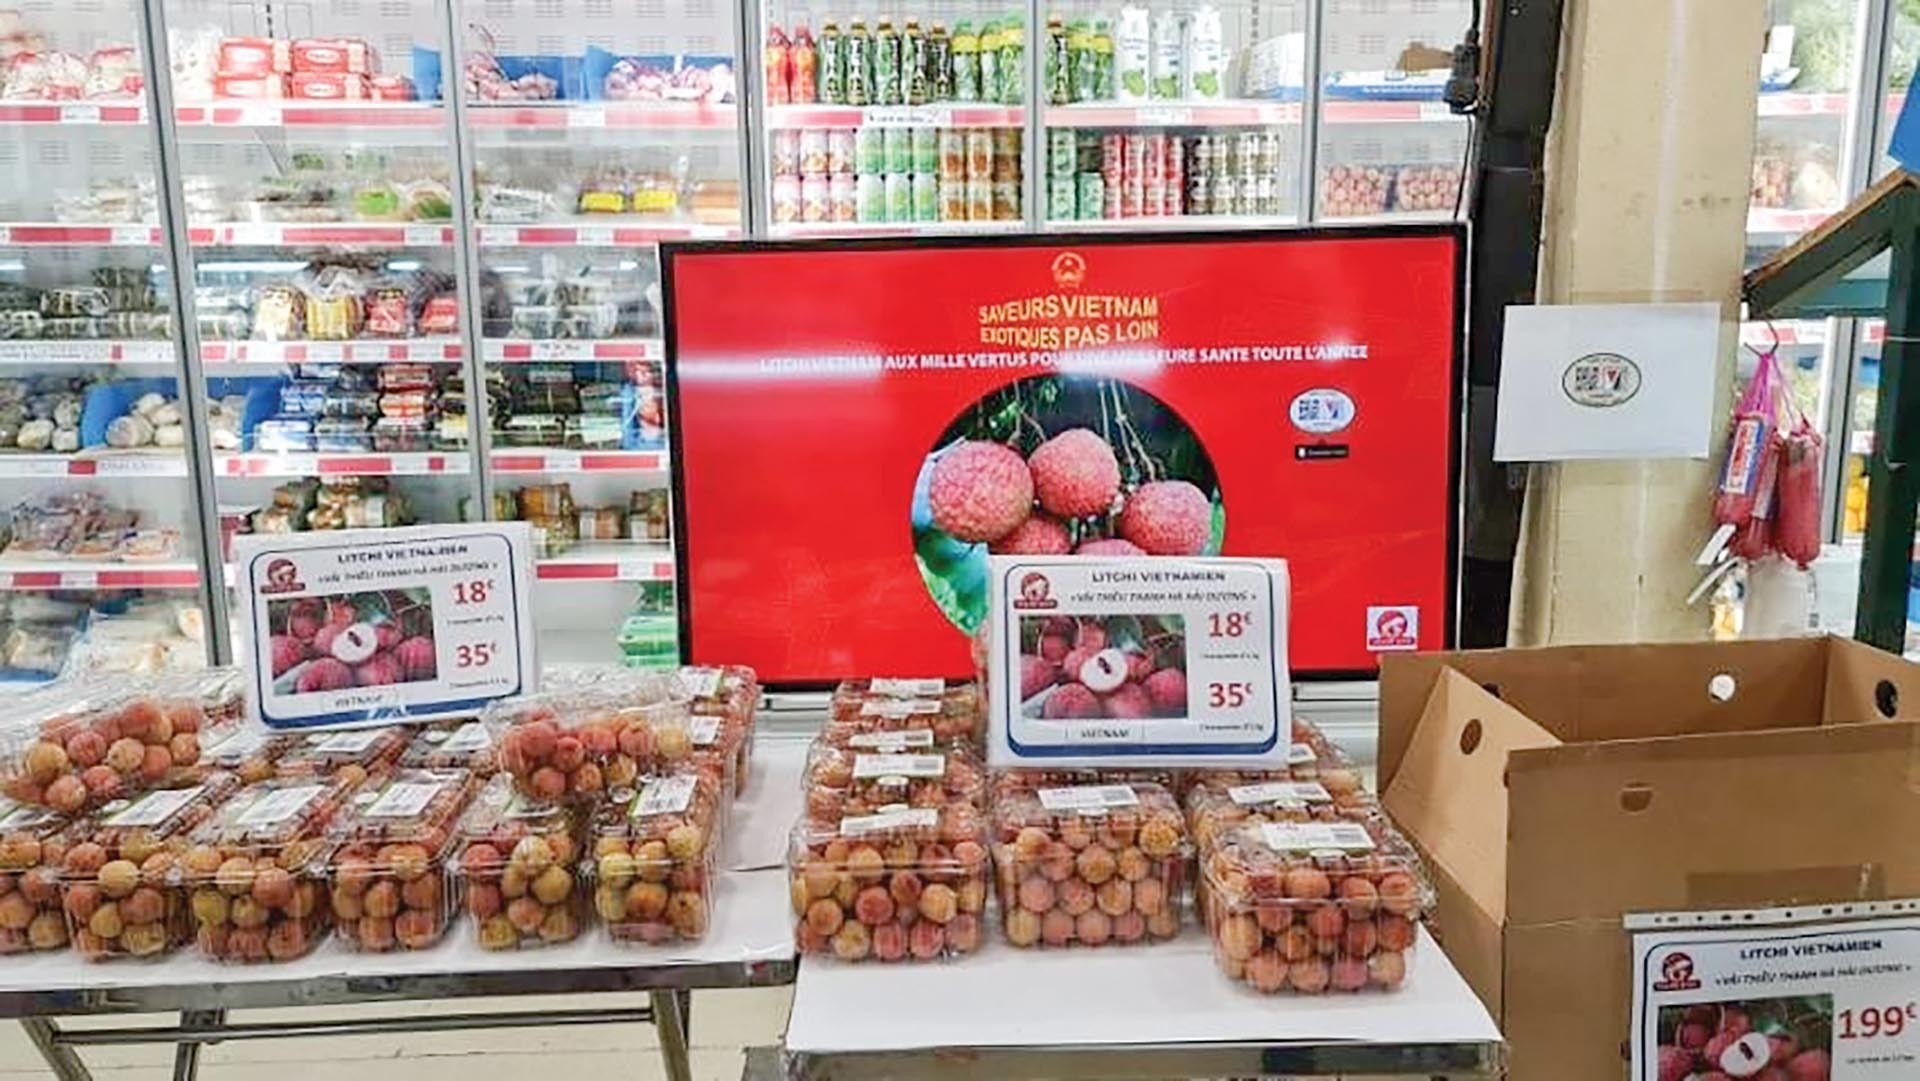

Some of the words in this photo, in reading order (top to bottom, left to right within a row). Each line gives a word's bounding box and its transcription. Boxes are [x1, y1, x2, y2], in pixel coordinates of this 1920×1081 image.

[978, 296, 1059, 324] SAVEURS
[1060, 295, 1158, 318] VIETNAM
[980, 326, 1060, 350] EXOTIQUES
[1065, 324, 1110, 349] PAS
[1116, 319, 1158, 342] LOIN
[885, 354, 918, 369] AUX
[920, 352, 966, 369] MILLE
[967, 352, 1027, 368] VERTUS
[1200, 347, 1249, 363] SANTE
[1252, 345, 1303, 361] TOUTE
[338, 551, 382, 564] LITCHI
[1092, 571, 1137, 583] LITCHI
[1140, 571, 1226, 583] VIETNAMIEN
[1740, 945, 1789, 960] LITCHI
[1792, 939, 1883, 957] VIETNAMIEN
